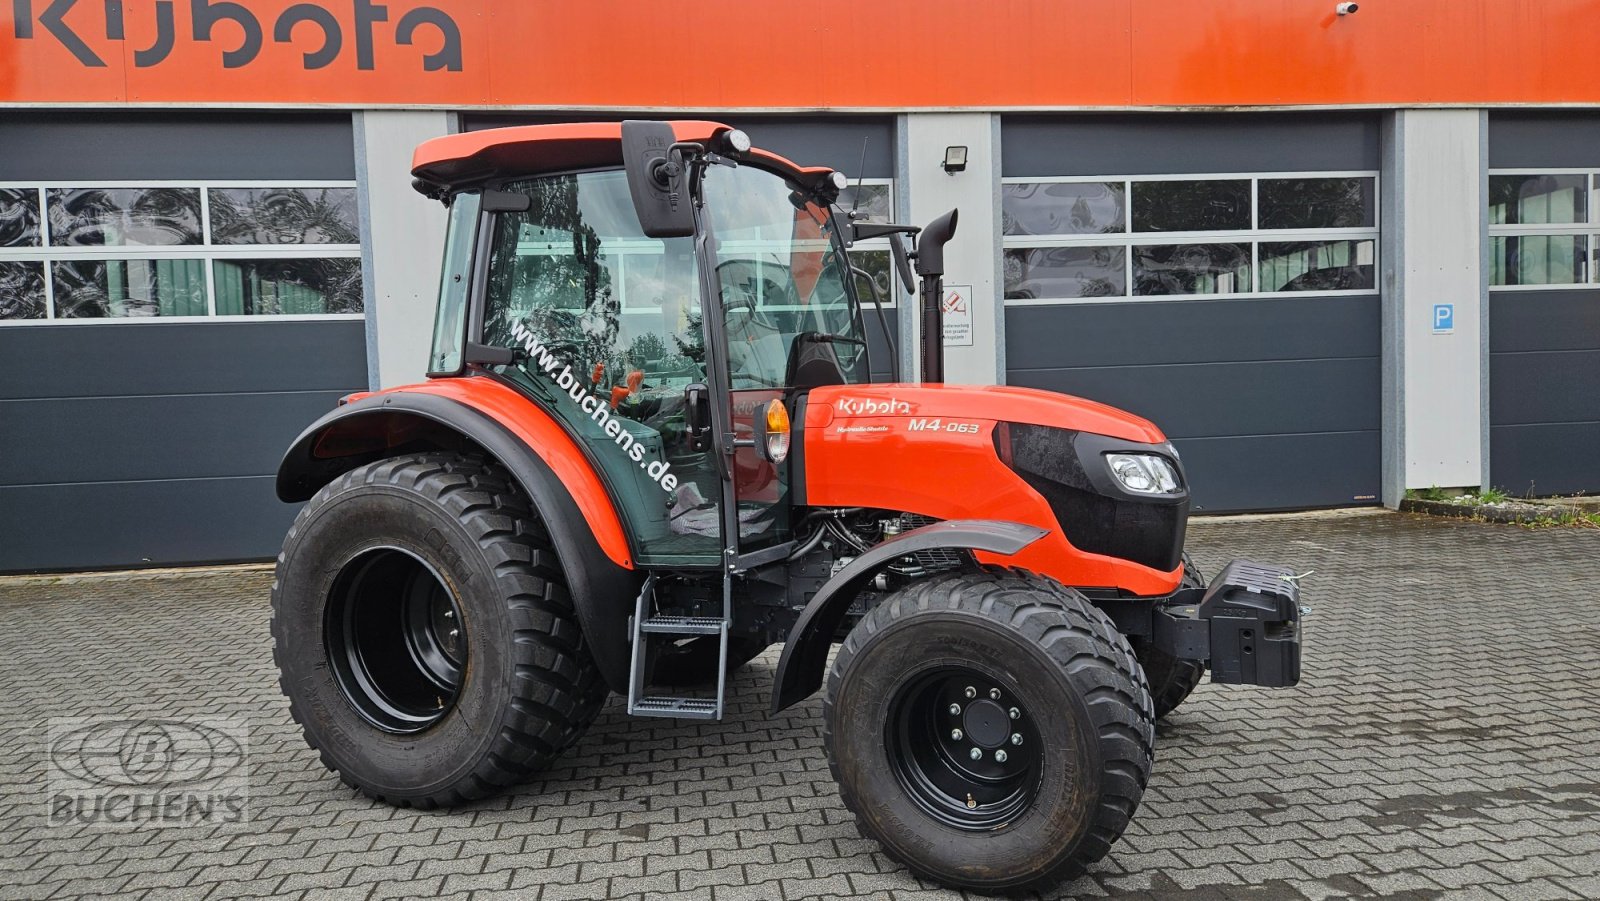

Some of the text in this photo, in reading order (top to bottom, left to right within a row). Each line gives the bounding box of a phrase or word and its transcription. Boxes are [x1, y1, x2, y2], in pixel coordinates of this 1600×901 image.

[15, 0, 463, 72] Kubota
[1436, 307, 1451, 326] P
[510, 319, 678, 492] www.buchens.de
[839, 398, 910, 414] Kubota
[908, 419, 980, 434] M4-063
